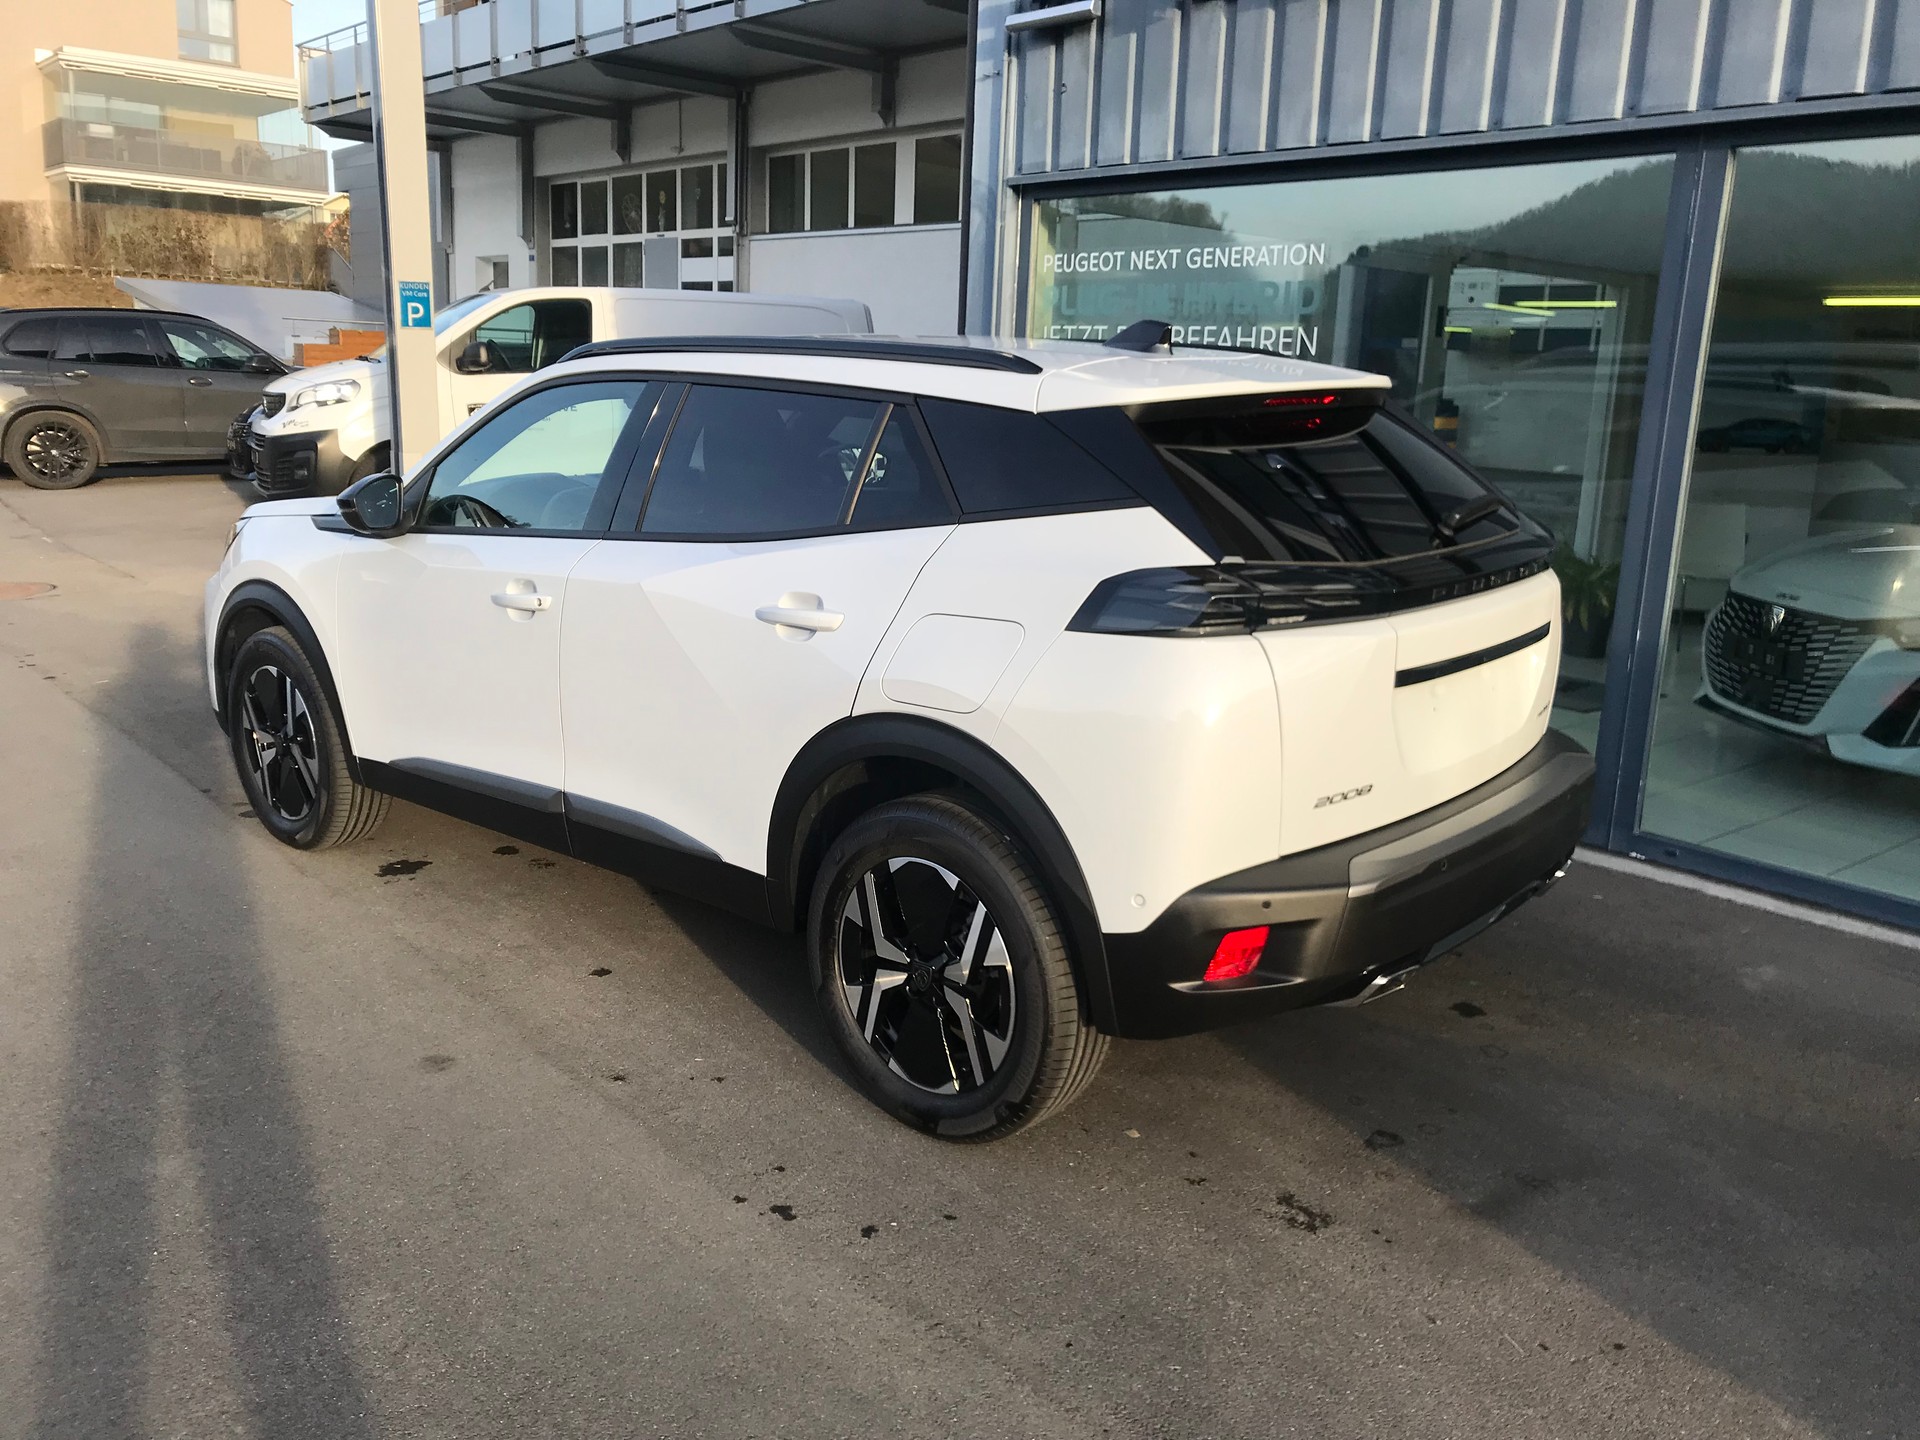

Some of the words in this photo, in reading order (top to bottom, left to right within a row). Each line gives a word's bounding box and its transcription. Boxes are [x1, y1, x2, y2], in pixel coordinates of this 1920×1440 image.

[1043, 251, 1126, 273] PEUGEOT
[1130, 248, 1182, 271] NEXT
[1186, 243, 1326, 269] GENERATION
[399, 282, 429, 290] KUNDEN
[407, 301, 424, 327] P
[1312, 784, 1374, 810] 2008
